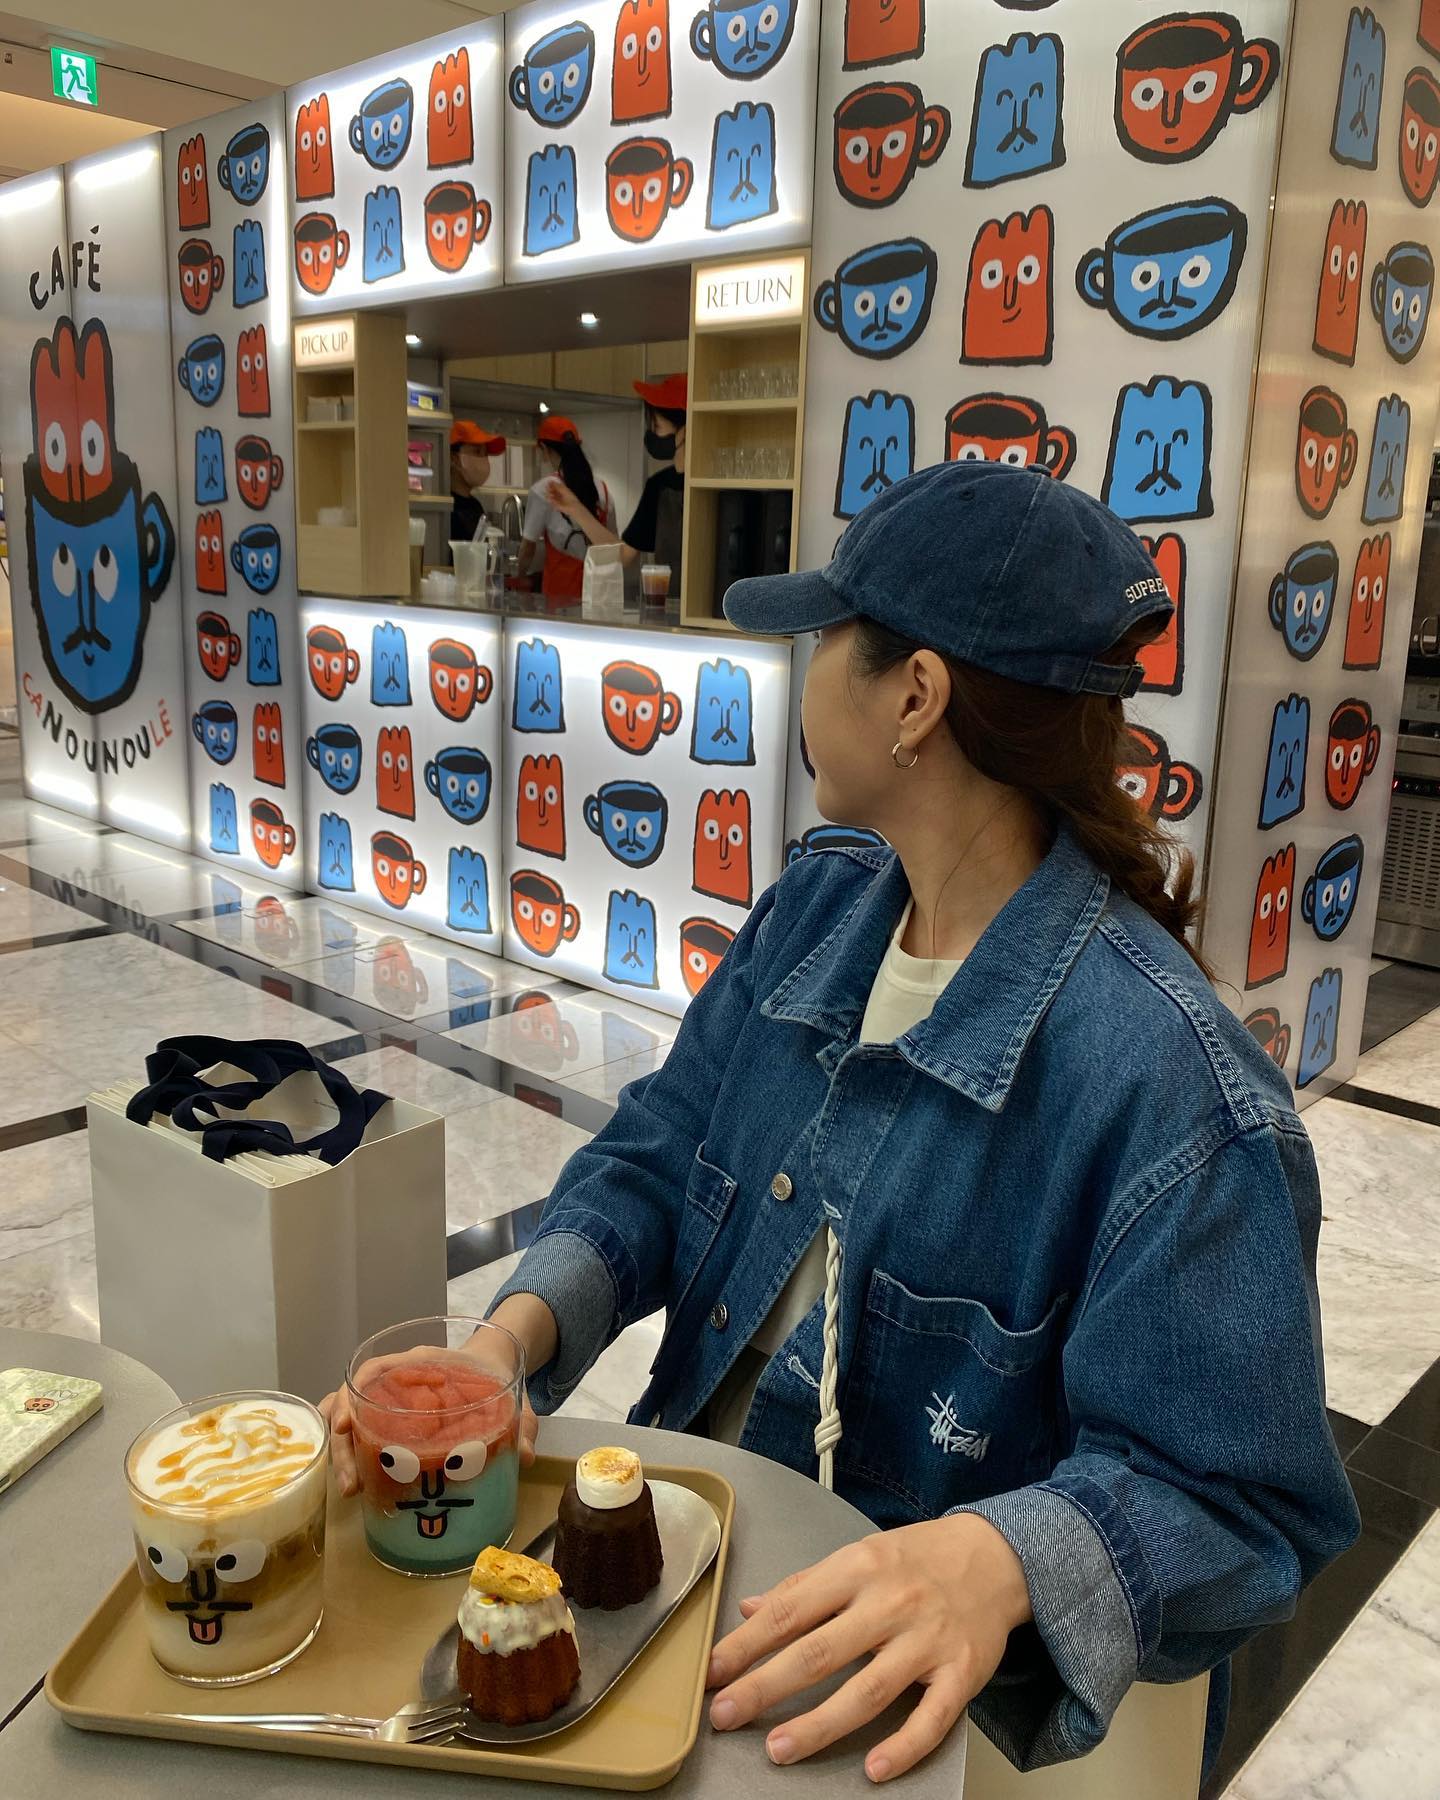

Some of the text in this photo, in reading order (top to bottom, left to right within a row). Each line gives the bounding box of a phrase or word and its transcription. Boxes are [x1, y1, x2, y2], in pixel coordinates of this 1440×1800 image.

[29, 225, 102, 310] CAFÉ
[706, 274, 793, 309] RETURN
[300, 330, 349, 355] PICK UP
[22, 671, 173, 775] CANOUNOULÉ
